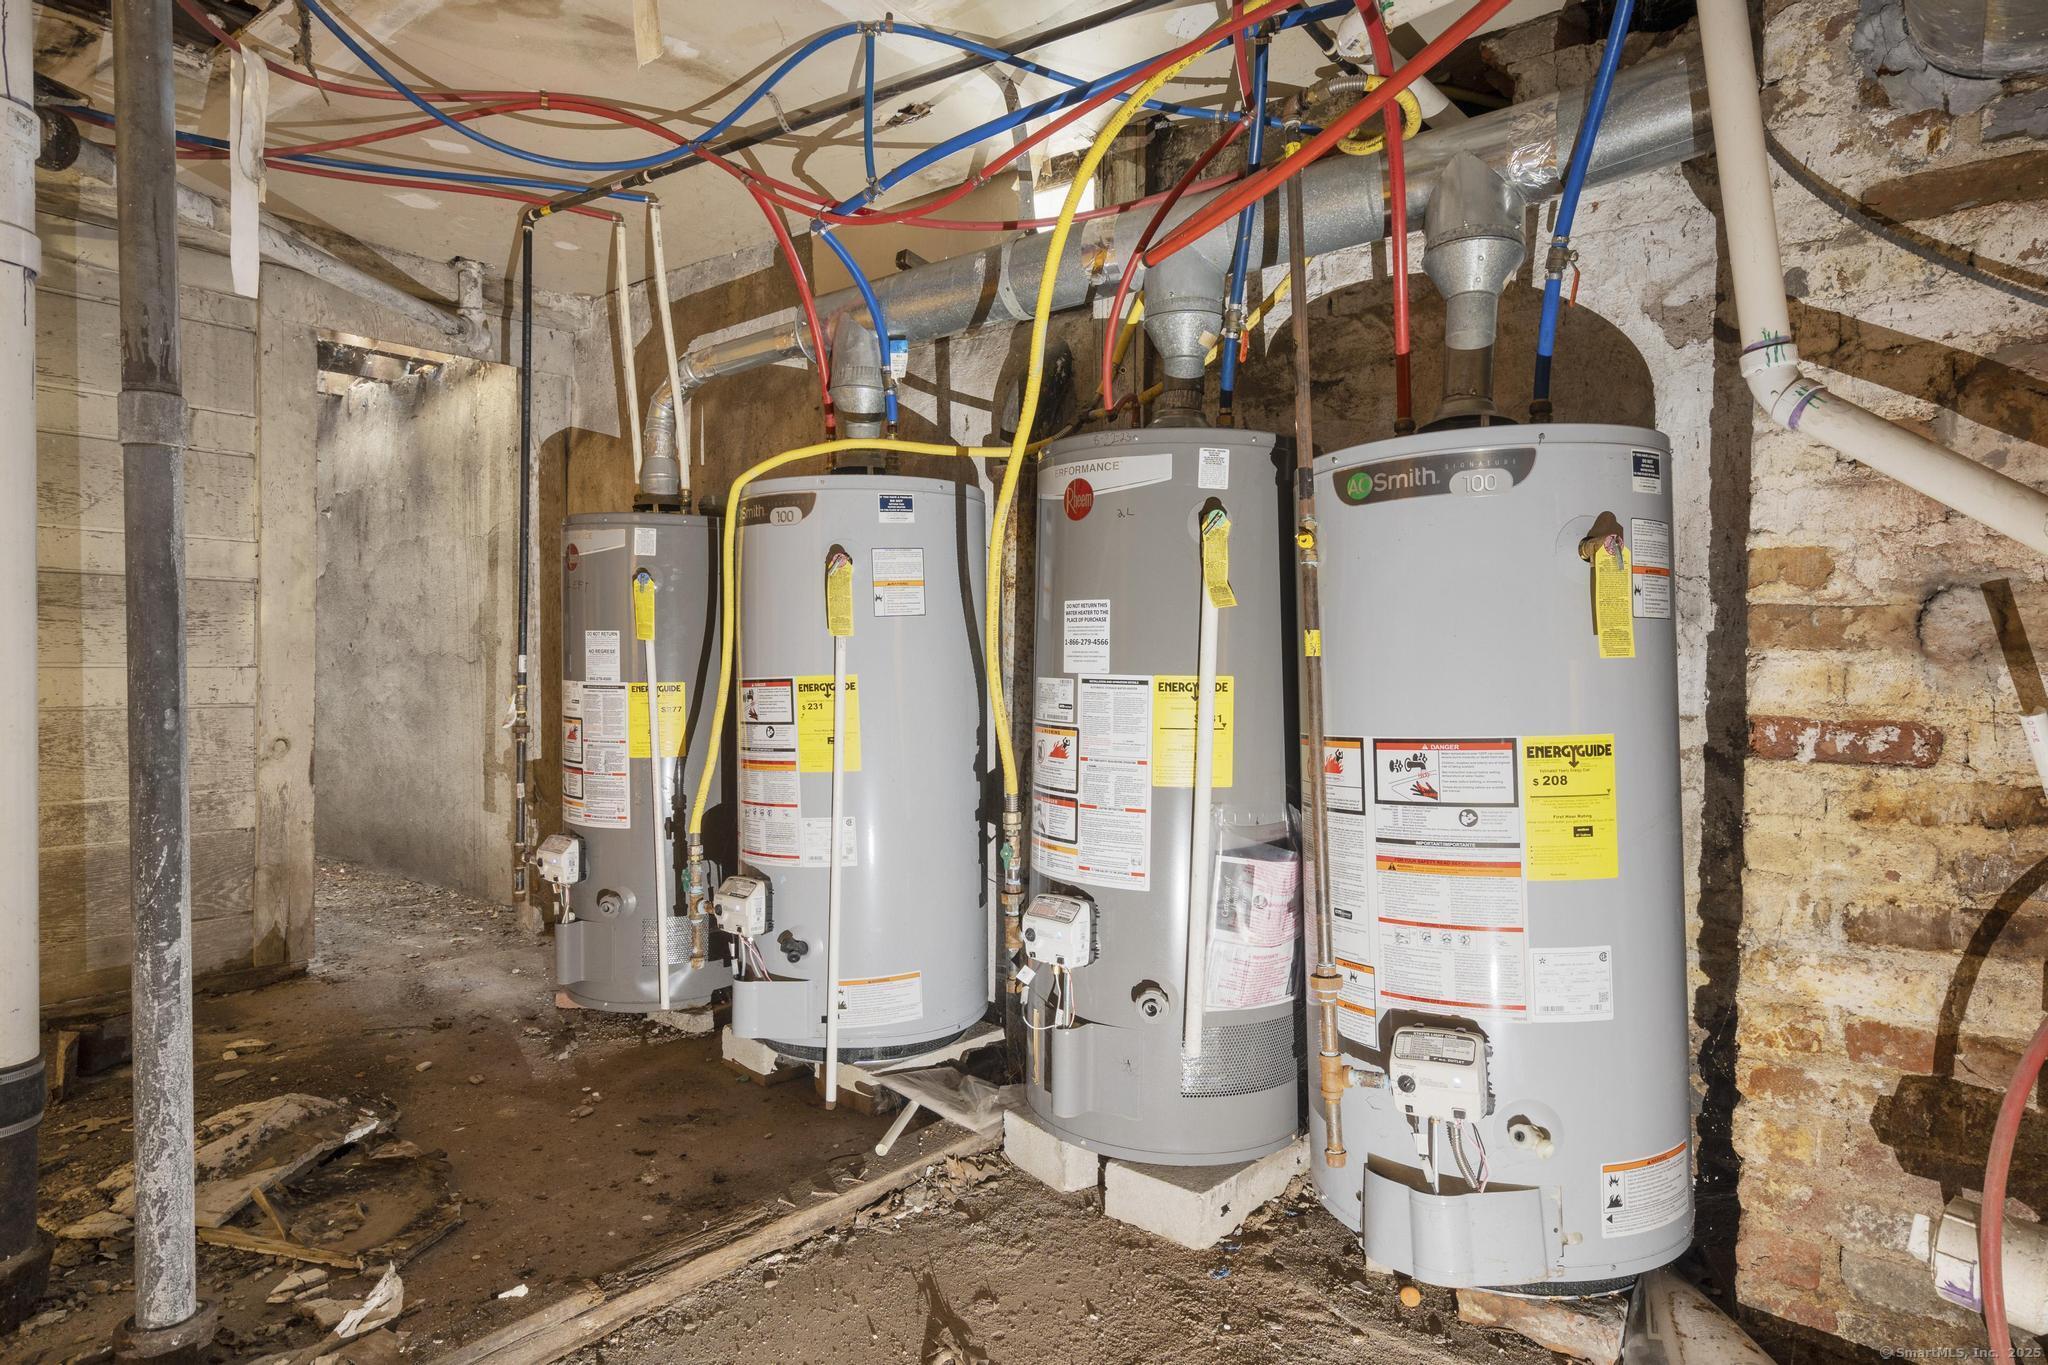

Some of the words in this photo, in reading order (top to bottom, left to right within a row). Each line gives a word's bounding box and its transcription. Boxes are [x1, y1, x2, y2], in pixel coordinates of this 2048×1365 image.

[1054, 460, 1120, 478] ERFORMANCE
[1462, 473, 1497, 492] 100
[1066, 480, 1092, 514] Rheem
[775, 510, 794, 523] 100
[1065, 638, 1109, 646] 1-866-279-4566
[631, 685, 681, 694] ENERYGUIDE
[798, 682, 856, 694] ENERGYGDE
[1158, 682, 1228, 695] ENERGYDE
[807, 703, 823, 711] 231
[1526, 744, 1612, 761] ENERGYGUIDE
[1542, 775, 1568, 786] 208
